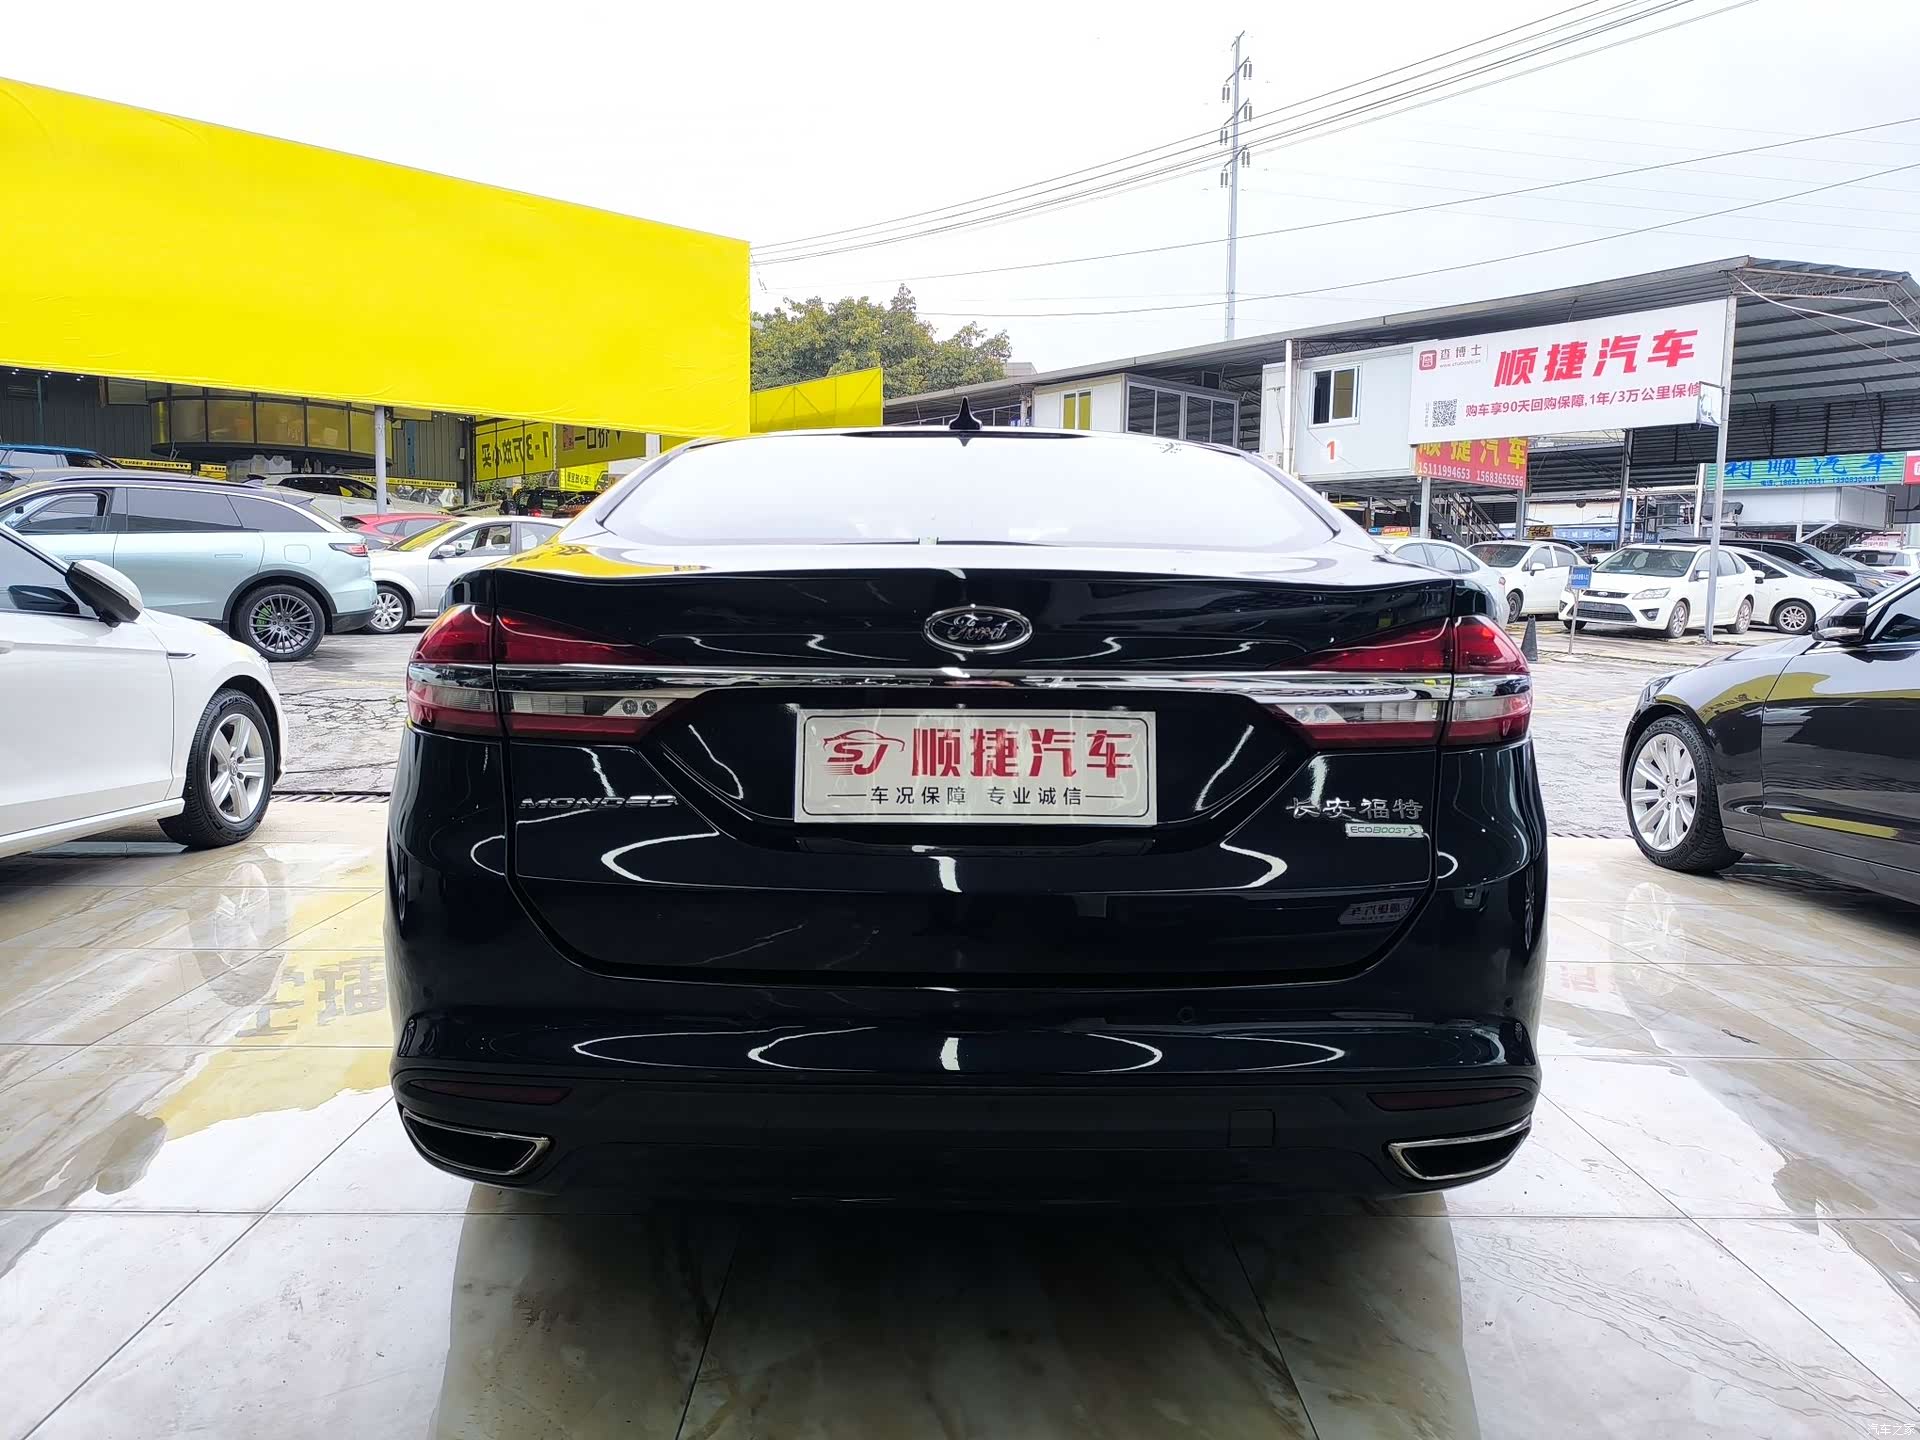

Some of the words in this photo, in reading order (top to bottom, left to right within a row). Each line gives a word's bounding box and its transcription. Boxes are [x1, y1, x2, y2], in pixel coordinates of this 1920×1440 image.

[1440, 344, 1482, 360] 查博士
[1493, 329, 1698, 388] 顺捷汽车
[1327, 440, 1335, 460] 1
[946, 613, 1008, 640] Ford
[911, 727, 1134, 778] 顺捷汽车
[518, 795, 679, 809] MONDEO
[870, 786, 967, 806] 车况保障
[987, 786, 1082, 806] 专业诚信
[1286, 797, 1424, 819] 长安福特
[1350, 826, 1408, 834] ECOBOOST
